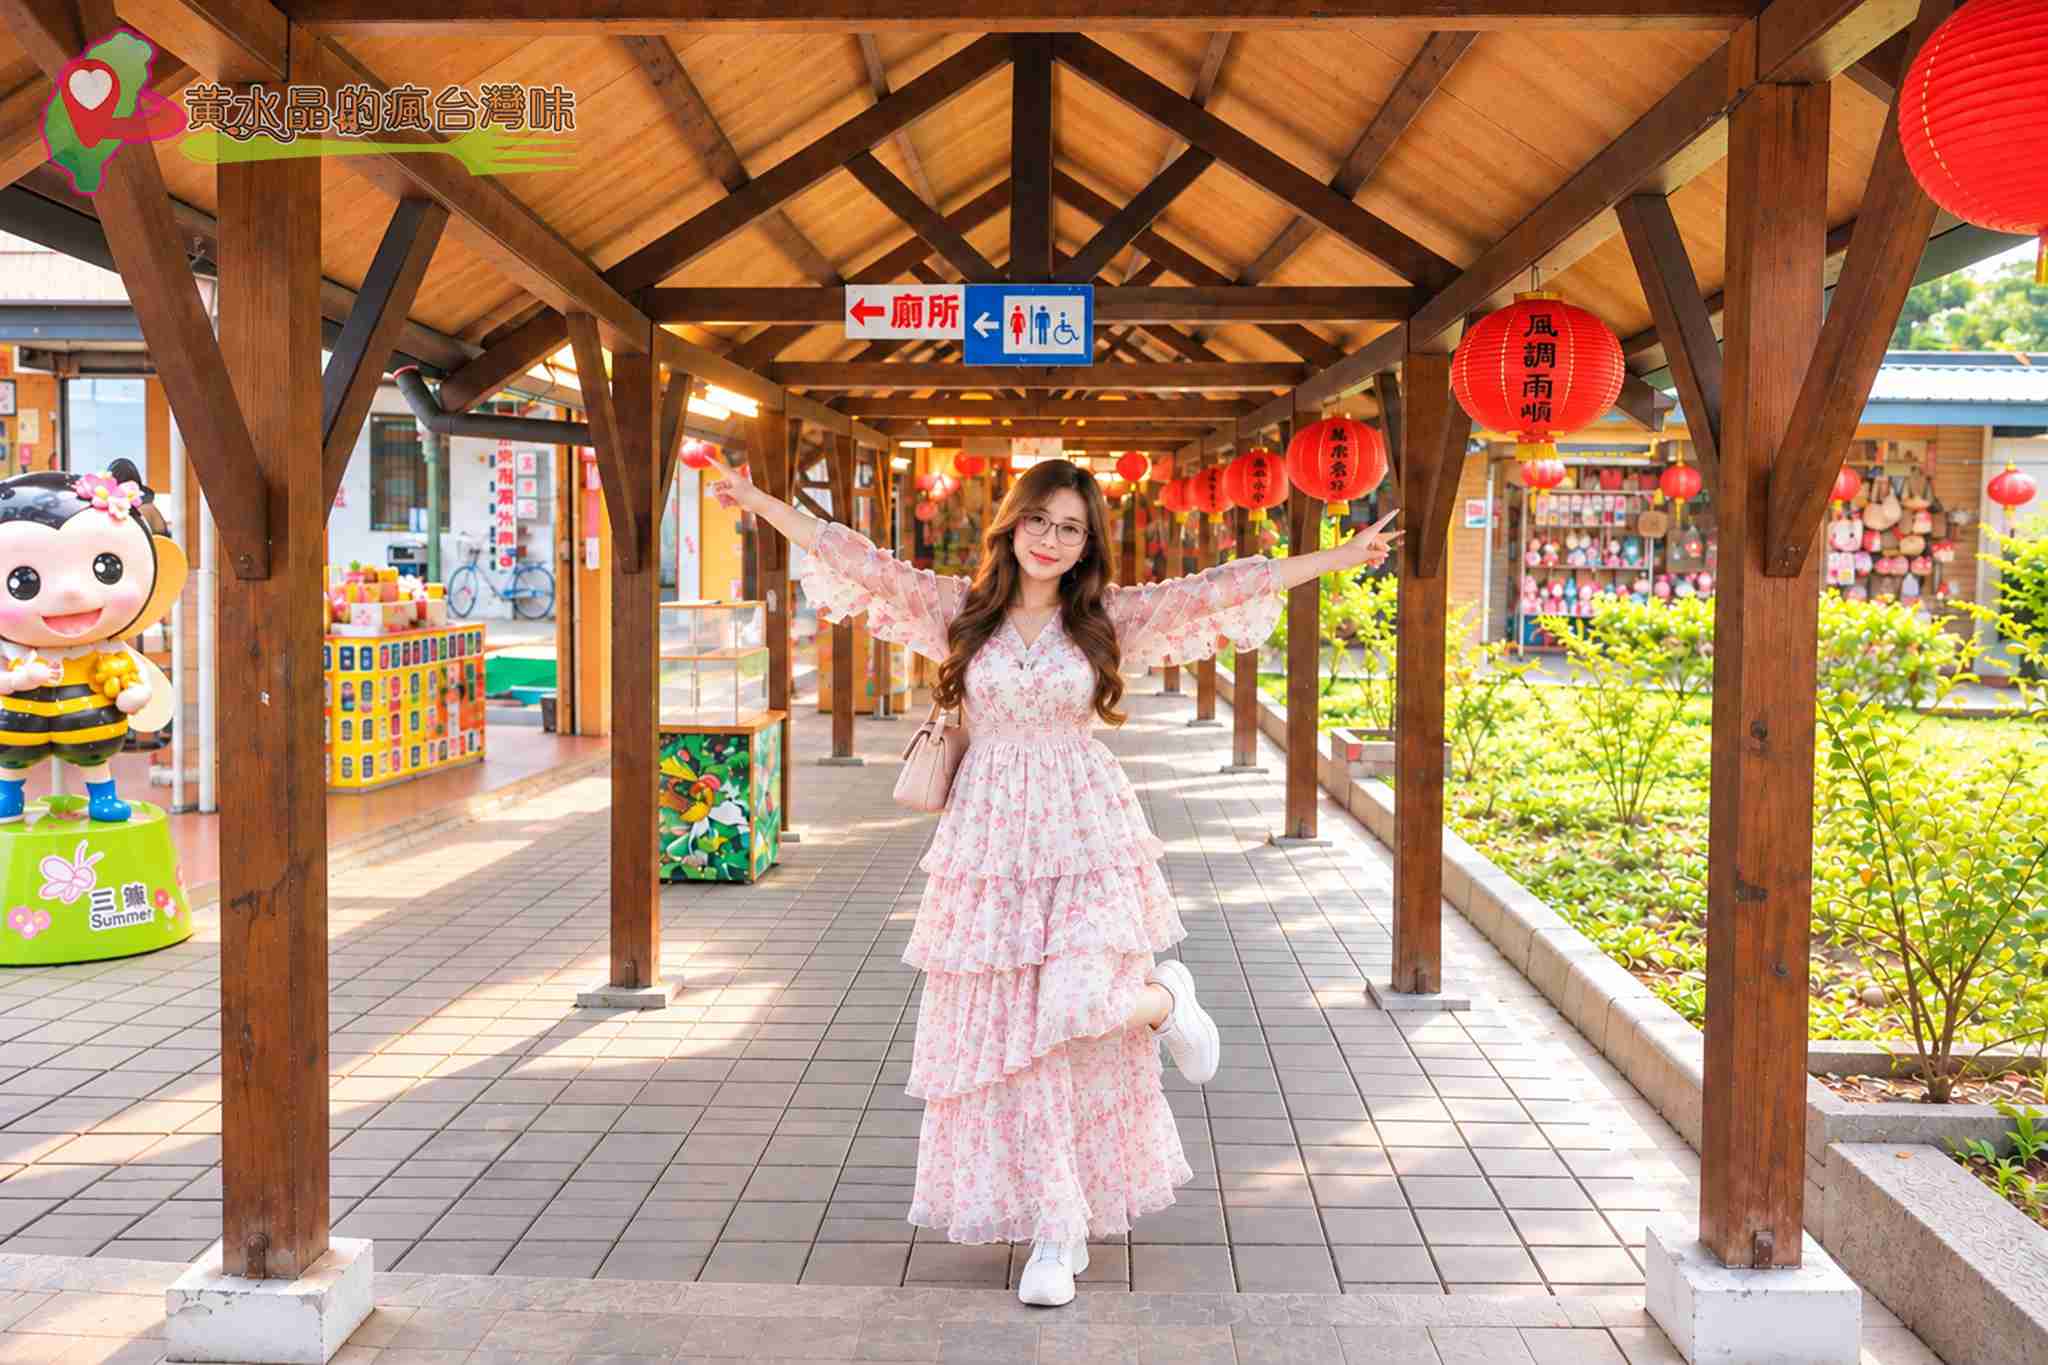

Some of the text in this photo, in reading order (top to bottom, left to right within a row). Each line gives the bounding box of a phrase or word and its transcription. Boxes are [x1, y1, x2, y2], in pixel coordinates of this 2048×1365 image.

[890, 293, 960, 329] 廁所
[1520, 313, 1558, 423] 風調雨順
[91, 908, 153, 929] Summer
